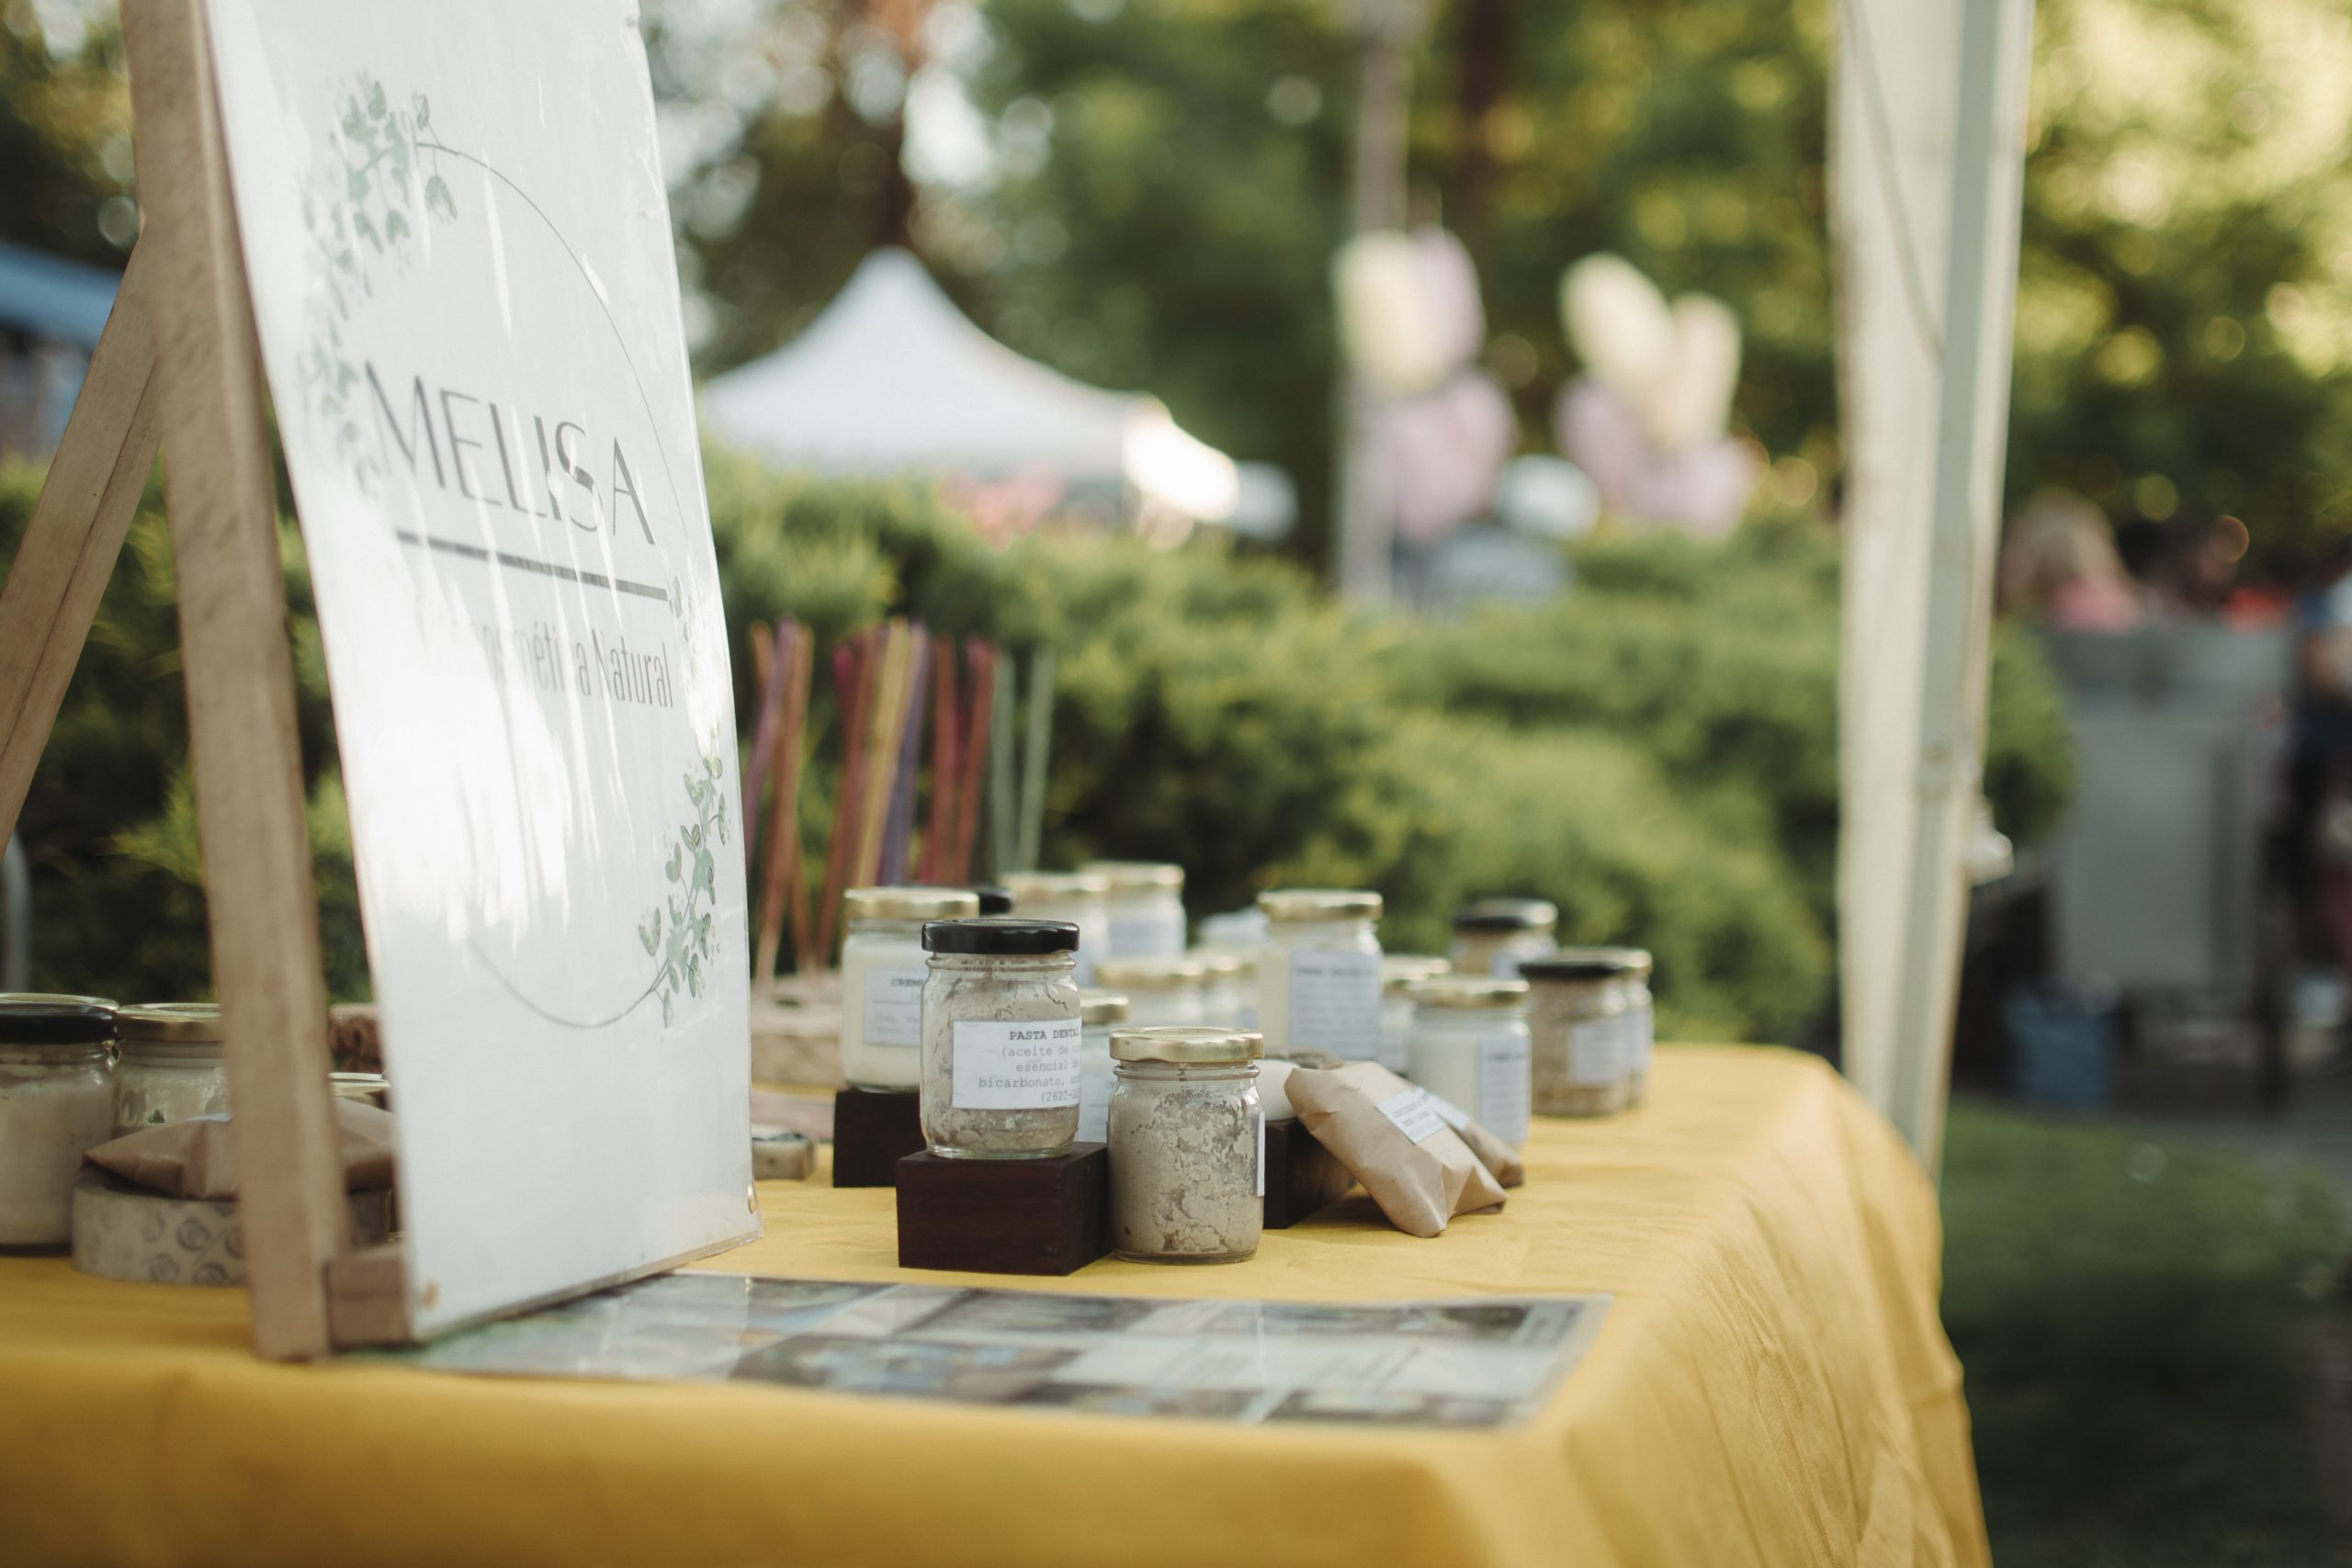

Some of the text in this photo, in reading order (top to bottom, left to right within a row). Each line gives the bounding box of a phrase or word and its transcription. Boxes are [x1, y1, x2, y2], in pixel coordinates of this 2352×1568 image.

[365, 359, 656, 546] MELISA
[591, 627, 673, 708] Natural
[1009, 1031, 1047, 1041] PASTA
[1001, 1045, 1053, 1057] (aceite
[1015, 1060, 1068, 1072] esencial
[978, 1077, 1066, 1089] bicarbonato,
